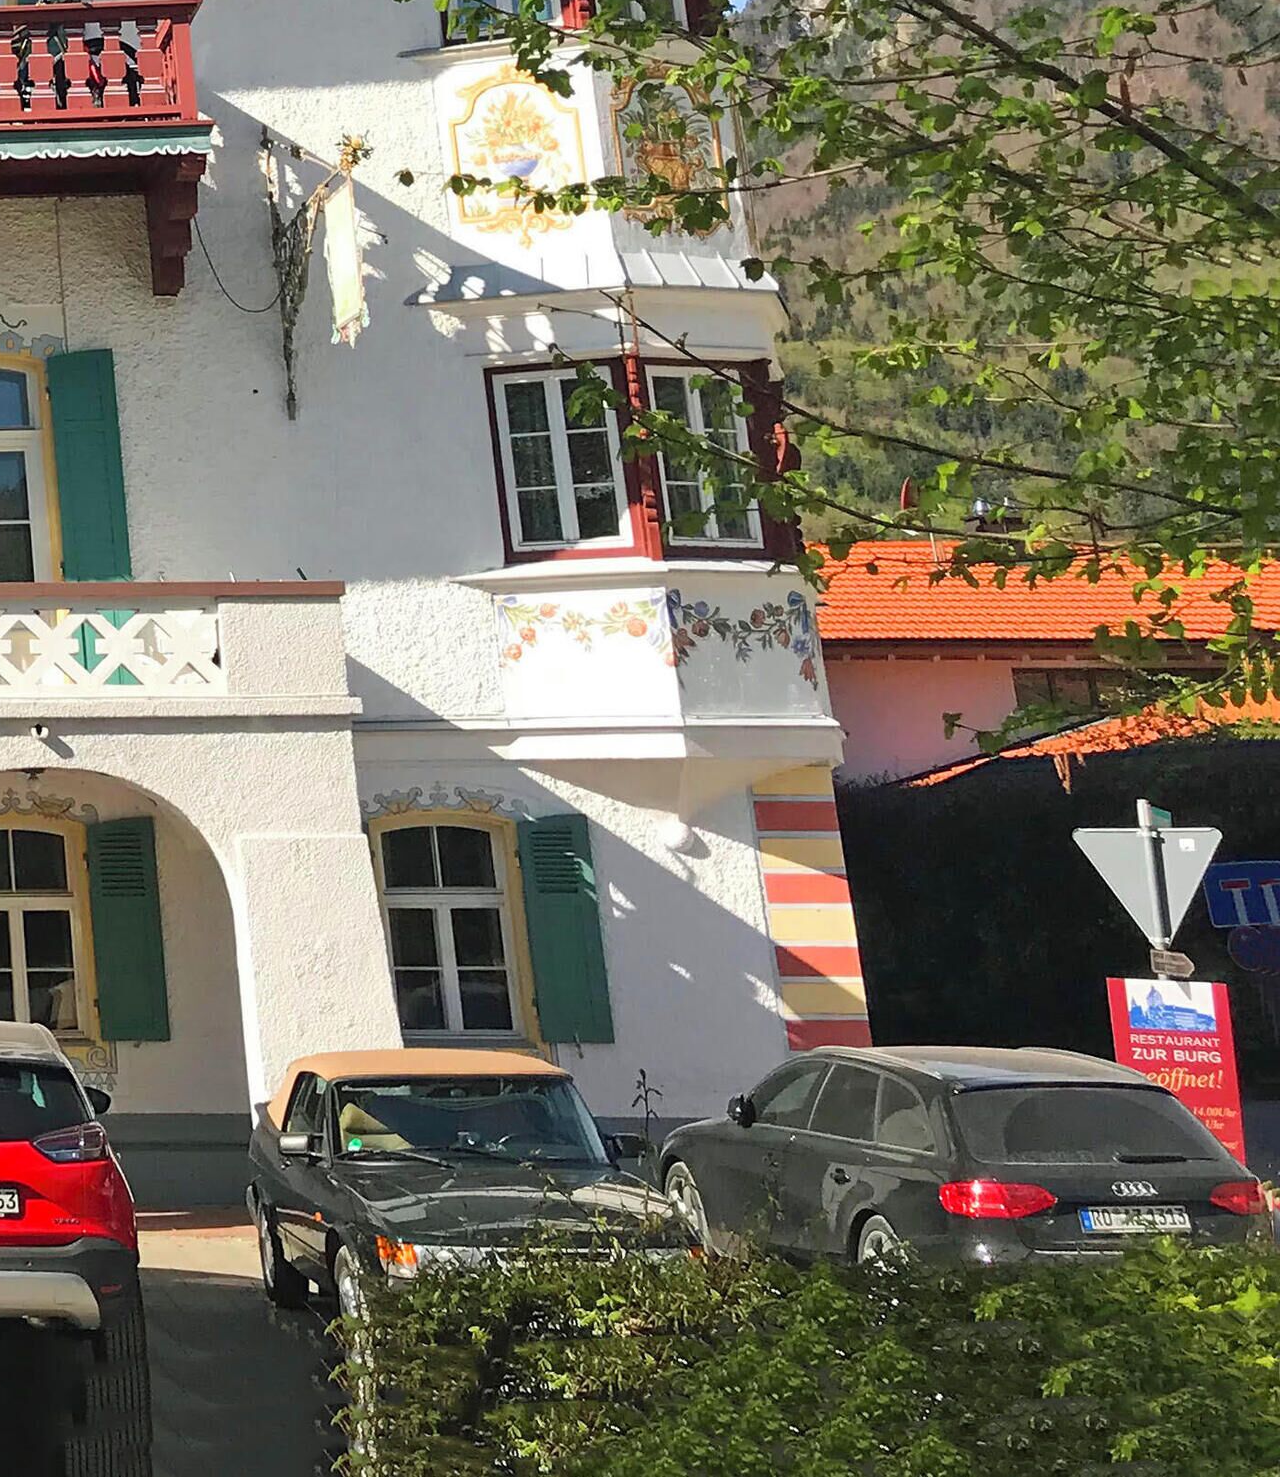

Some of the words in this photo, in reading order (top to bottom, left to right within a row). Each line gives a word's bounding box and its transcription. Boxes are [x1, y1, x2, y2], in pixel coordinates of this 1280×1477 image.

[1129, 1033, 1220, 1048] RESTAURANT
[1131, 1047, 1168, 1060] ZUR
[1173, 1049, 1222, 1063] BURG
[1144, 1066, 1224, 1092] eöffnet!
[1092, 1208, 1112, 1226] RO
